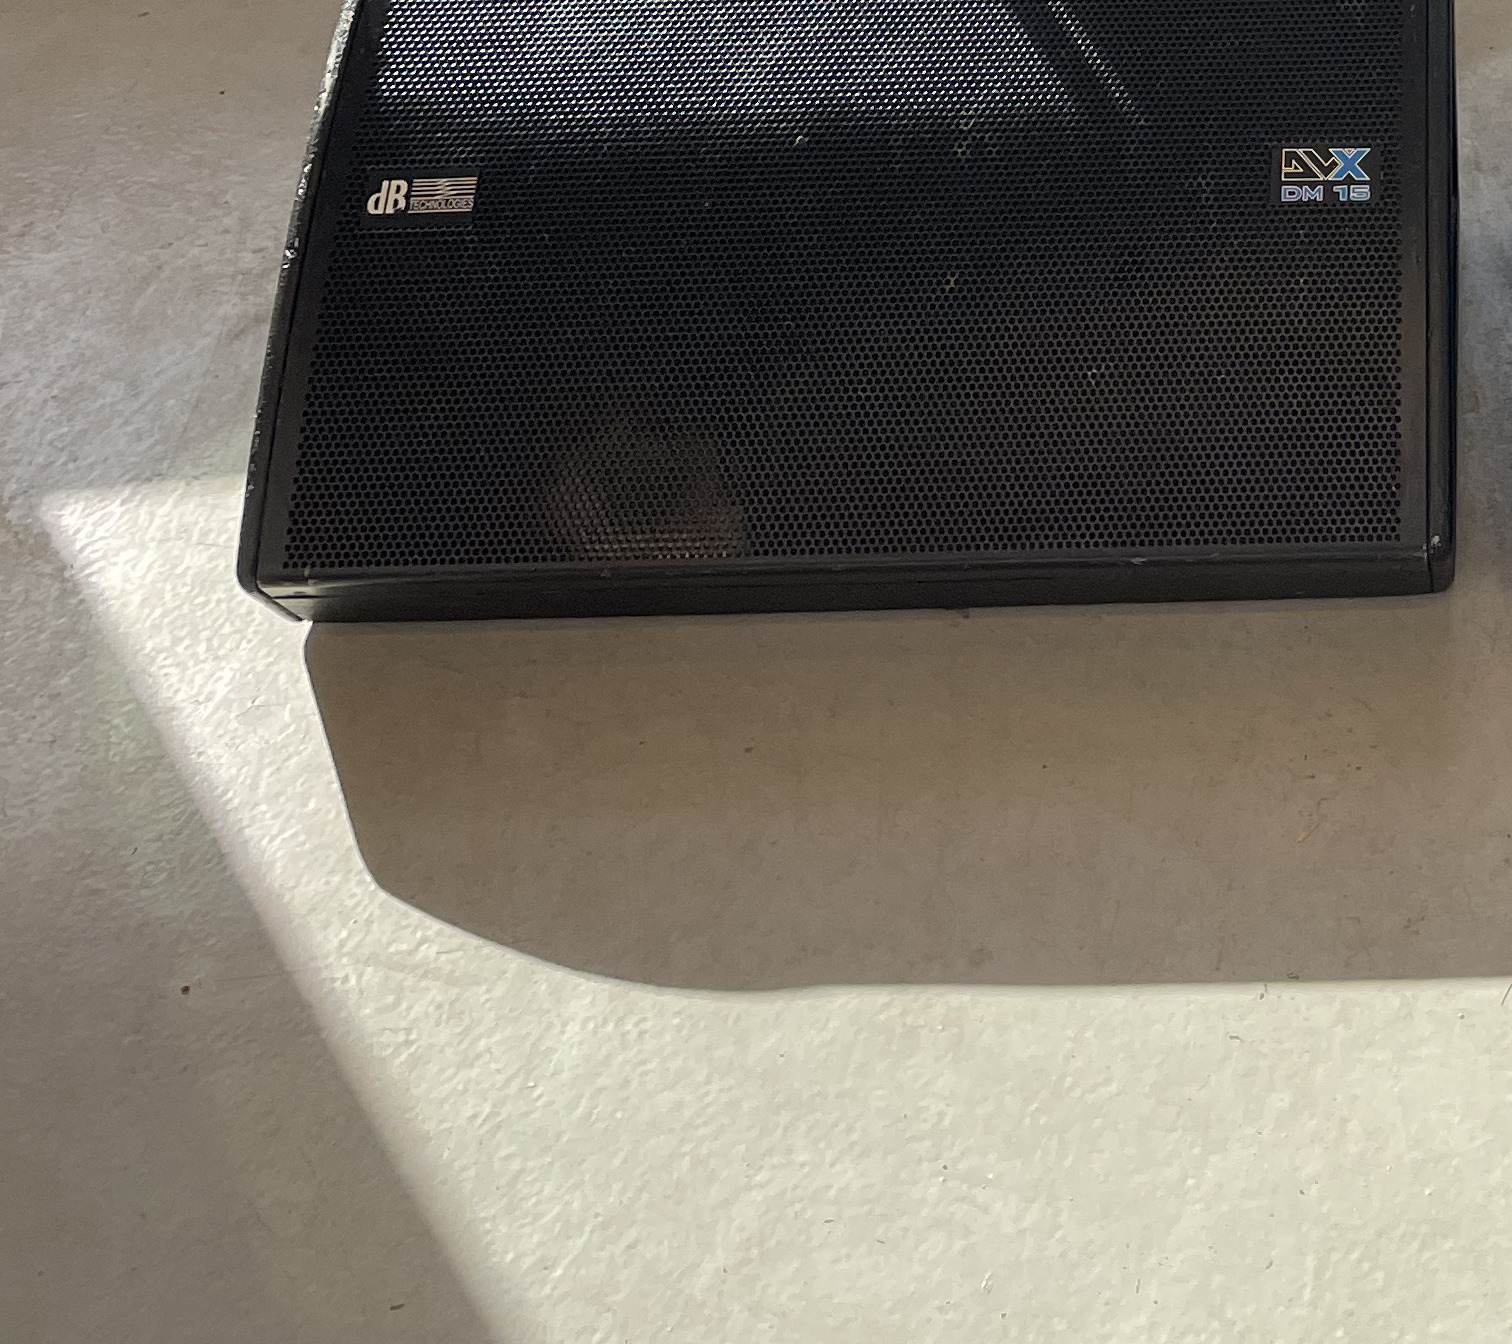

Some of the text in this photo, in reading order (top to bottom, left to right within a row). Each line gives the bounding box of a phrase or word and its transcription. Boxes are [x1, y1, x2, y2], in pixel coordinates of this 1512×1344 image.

[367, 179, 475, 215] dB TECHNOLOGIES
[1281, 185, 1371, 202] DM 15
